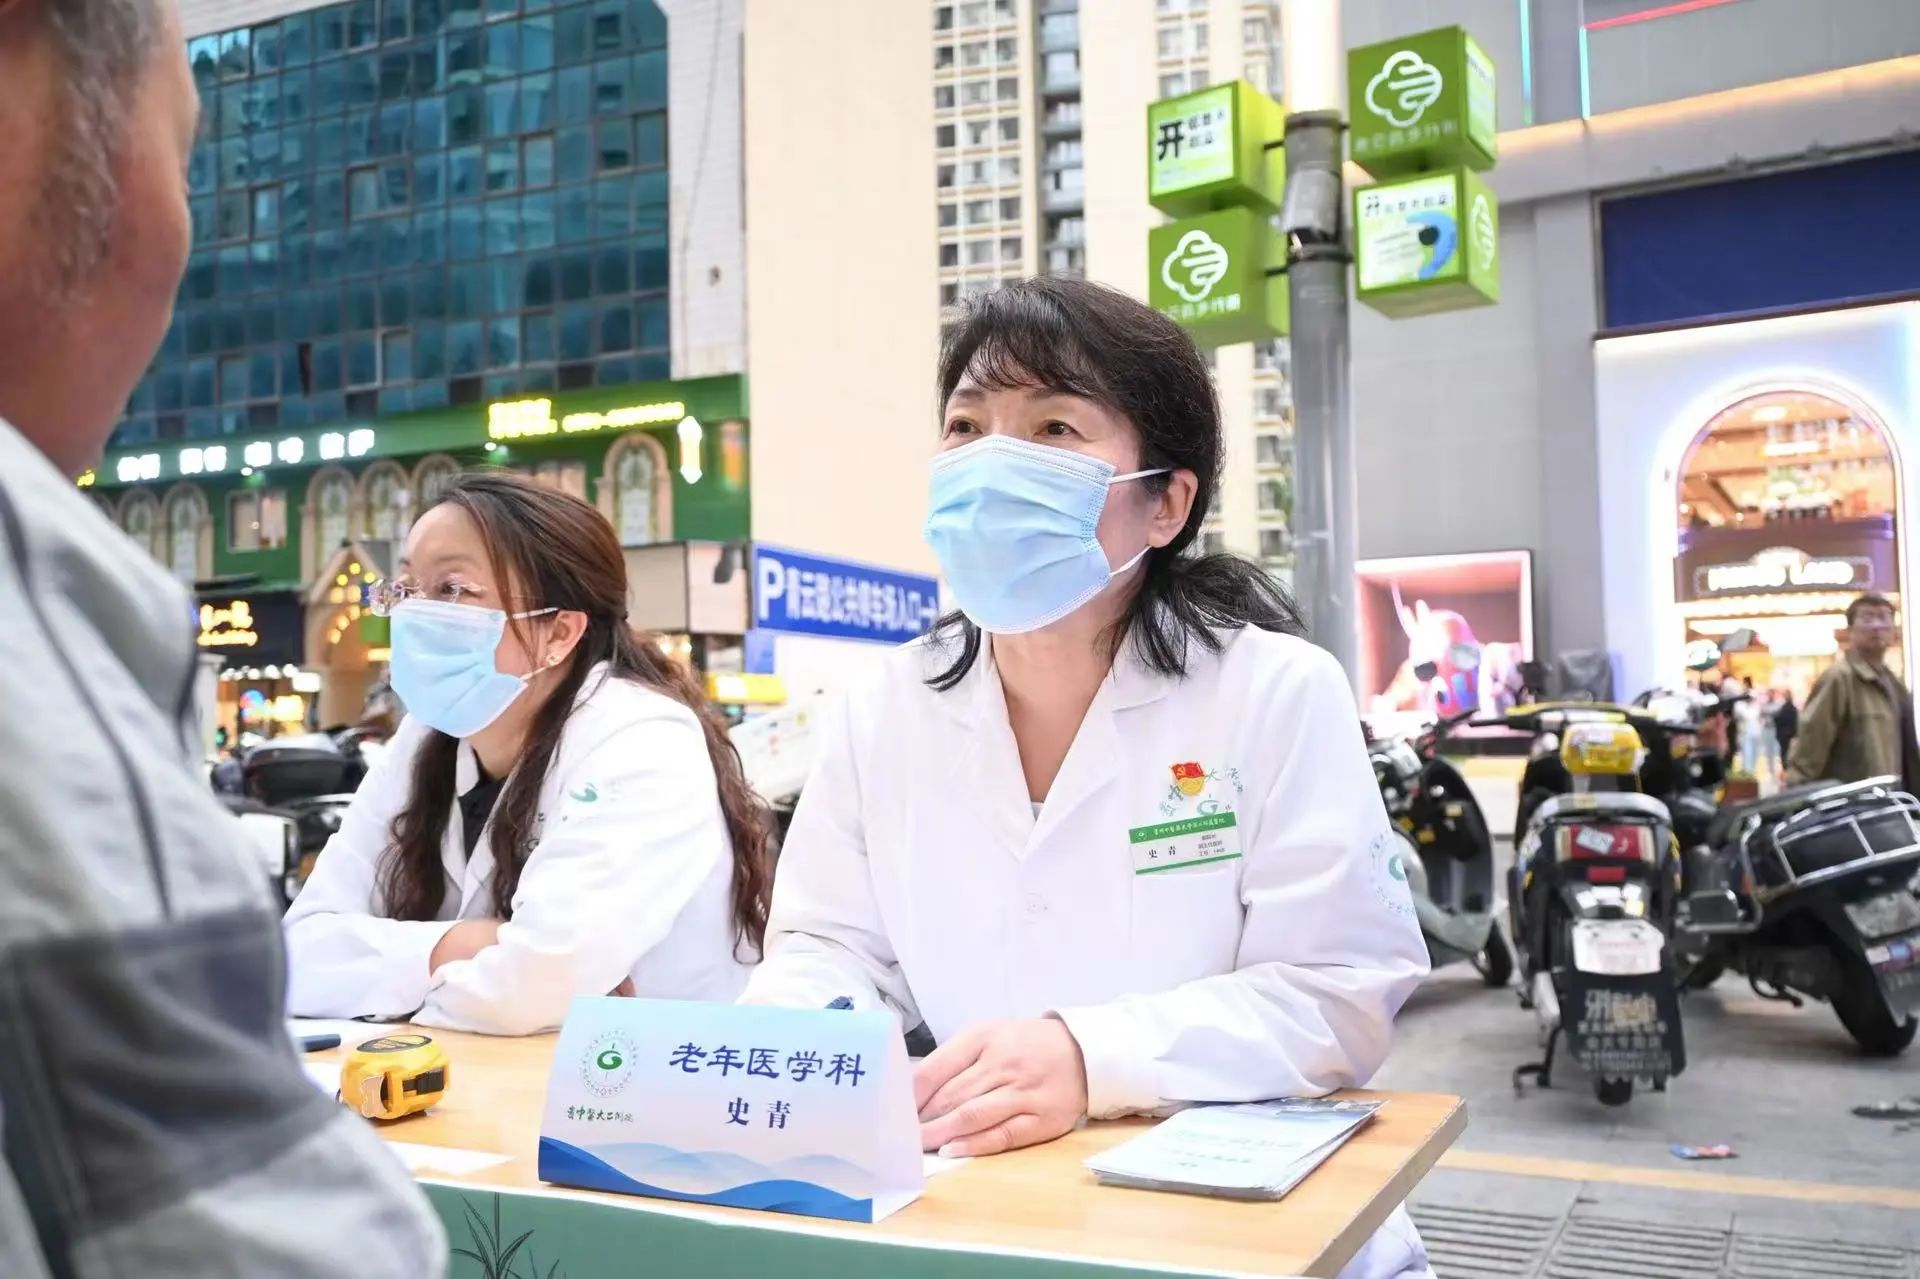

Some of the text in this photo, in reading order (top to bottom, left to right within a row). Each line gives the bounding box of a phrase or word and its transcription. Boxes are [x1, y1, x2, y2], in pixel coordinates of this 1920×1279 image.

[758, 557, 785, 620] P
[669, 1042, 866, 1087] 老年医学科
